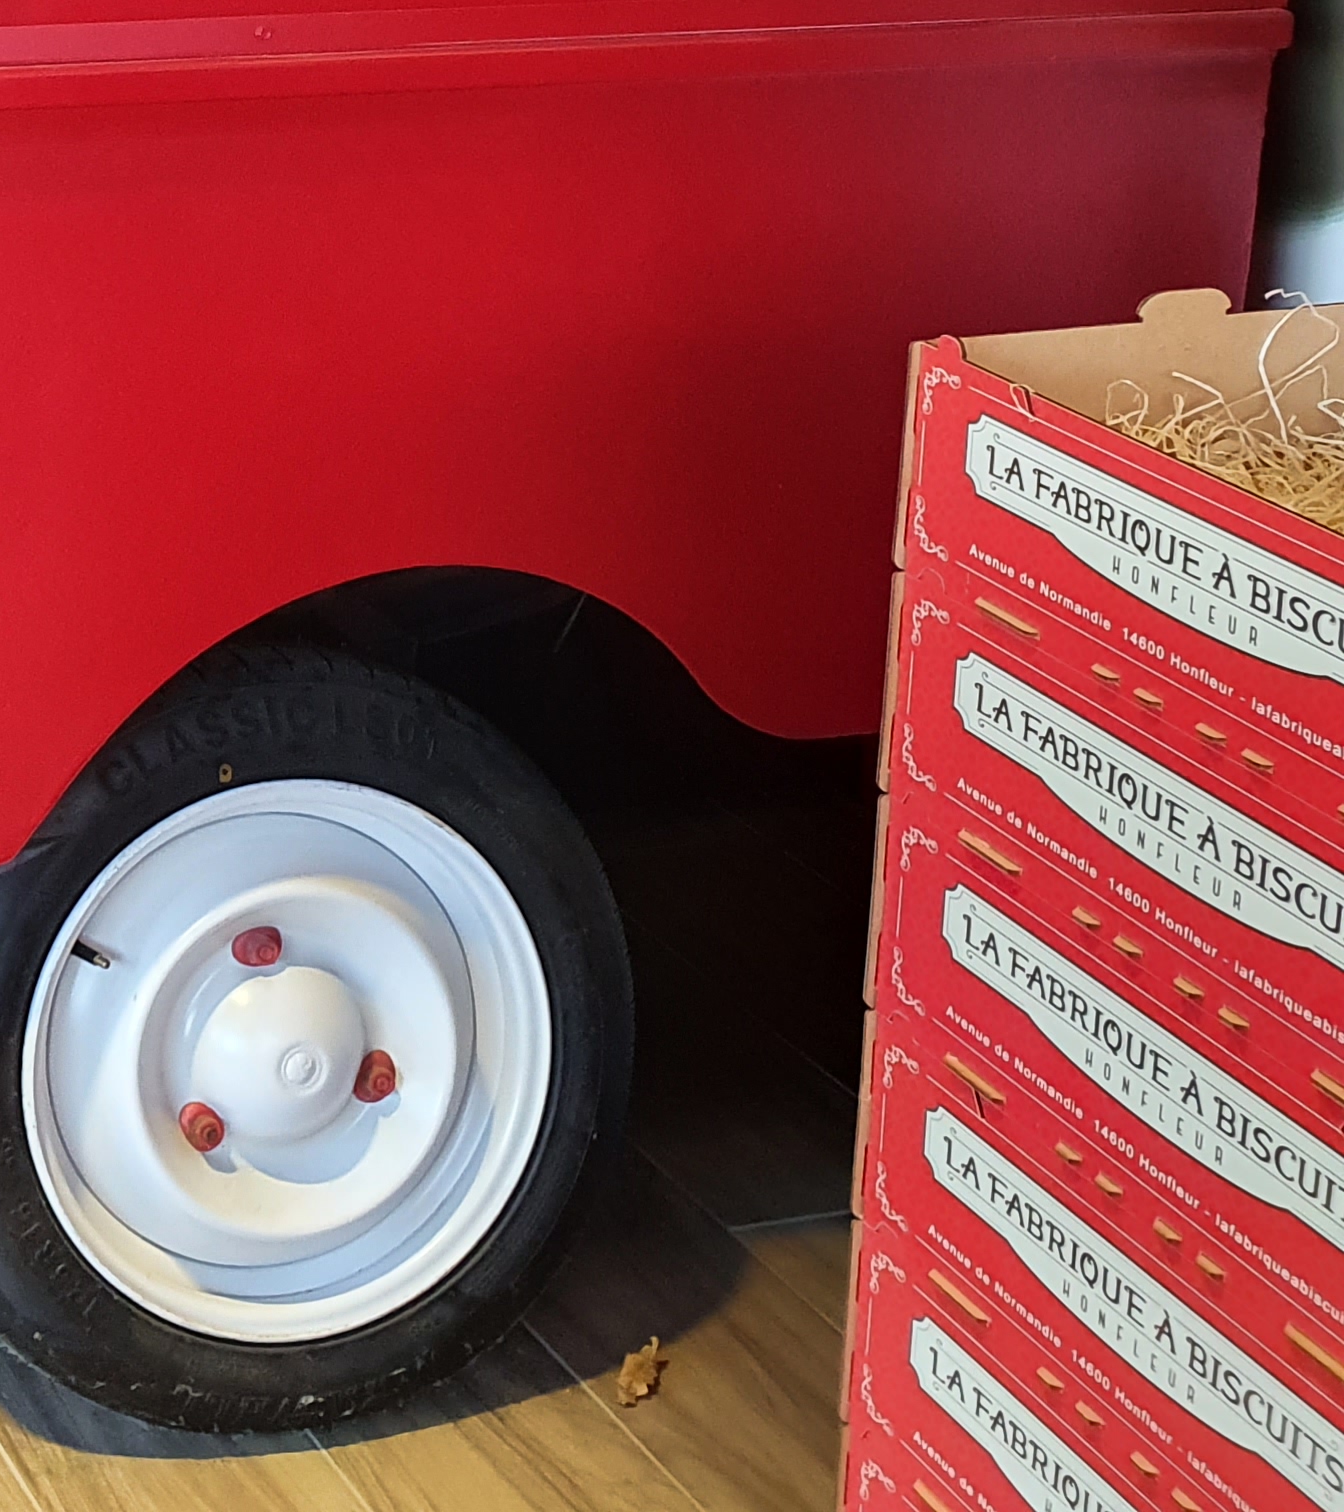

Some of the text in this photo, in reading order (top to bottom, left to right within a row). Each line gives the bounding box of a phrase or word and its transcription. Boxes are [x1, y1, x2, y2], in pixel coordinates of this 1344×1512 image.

[986, 445, 1026, 494] LA
[1033, 469, 1206, 582] FABRIQUE
[1212, 553, 1238, 600] À
[1111, 556, 1259, 648] HONFLEUR
[969, 543, 1016, 579] Avenue
[1019, 571, 1036, 590] de
[1039, 581, 1112, 632] Normandie
[1121, 627, 1166, 662] 14600
[1170, 649, 1236, 700] Honfleur
[1251, 696, 1344, 760] lafabriquea
[974, 682, 1014, 734] LA
[1020, 709, 1190, 842] FABRIQUE
[1196, 815, 1222, 864] À
[957, 776, 1004, 817] Avenue
[1006, 806, 1024, 830] de
[1026, 823, 1098, 881] Normandie
[1108, 877, 1150, 914] 14600
[1155, 899, 1220, 960] Honfleur
[1098, 805, 1242, 912] HONFLEUR
[945, 1005, 991, 1048] Avenue
[994, 1043, 1010, 1062] de
[1014, 1057, 1085, 1120] Normandie
[1093, 1119, 1136, 1160] 14600
[1139, 1153, 1201, 1210] Honfleur
[963, 913, 1344, 1222] LA FABRIQUE À BISCUI
[1085, 1047, 1224, 1166] HONFLEUR
[927, 1223, 972, 1272] Avenue
[975, 1262, 992, 1288] de
[994, 1276, 1062, 1350] Normandie
[1071, 1348, 1112, 1392] 14600
[1114, 1385, 1174, 1447] Honfleur
[929, 1346, 966, 1404] LA
[943, 1135, 1344, 1494] LA FABRIQUE À BISCUITS
[1061, 1279, 1196, 1405] HONFLEUR
[912, 1430, 975, 1498] Avenue de
